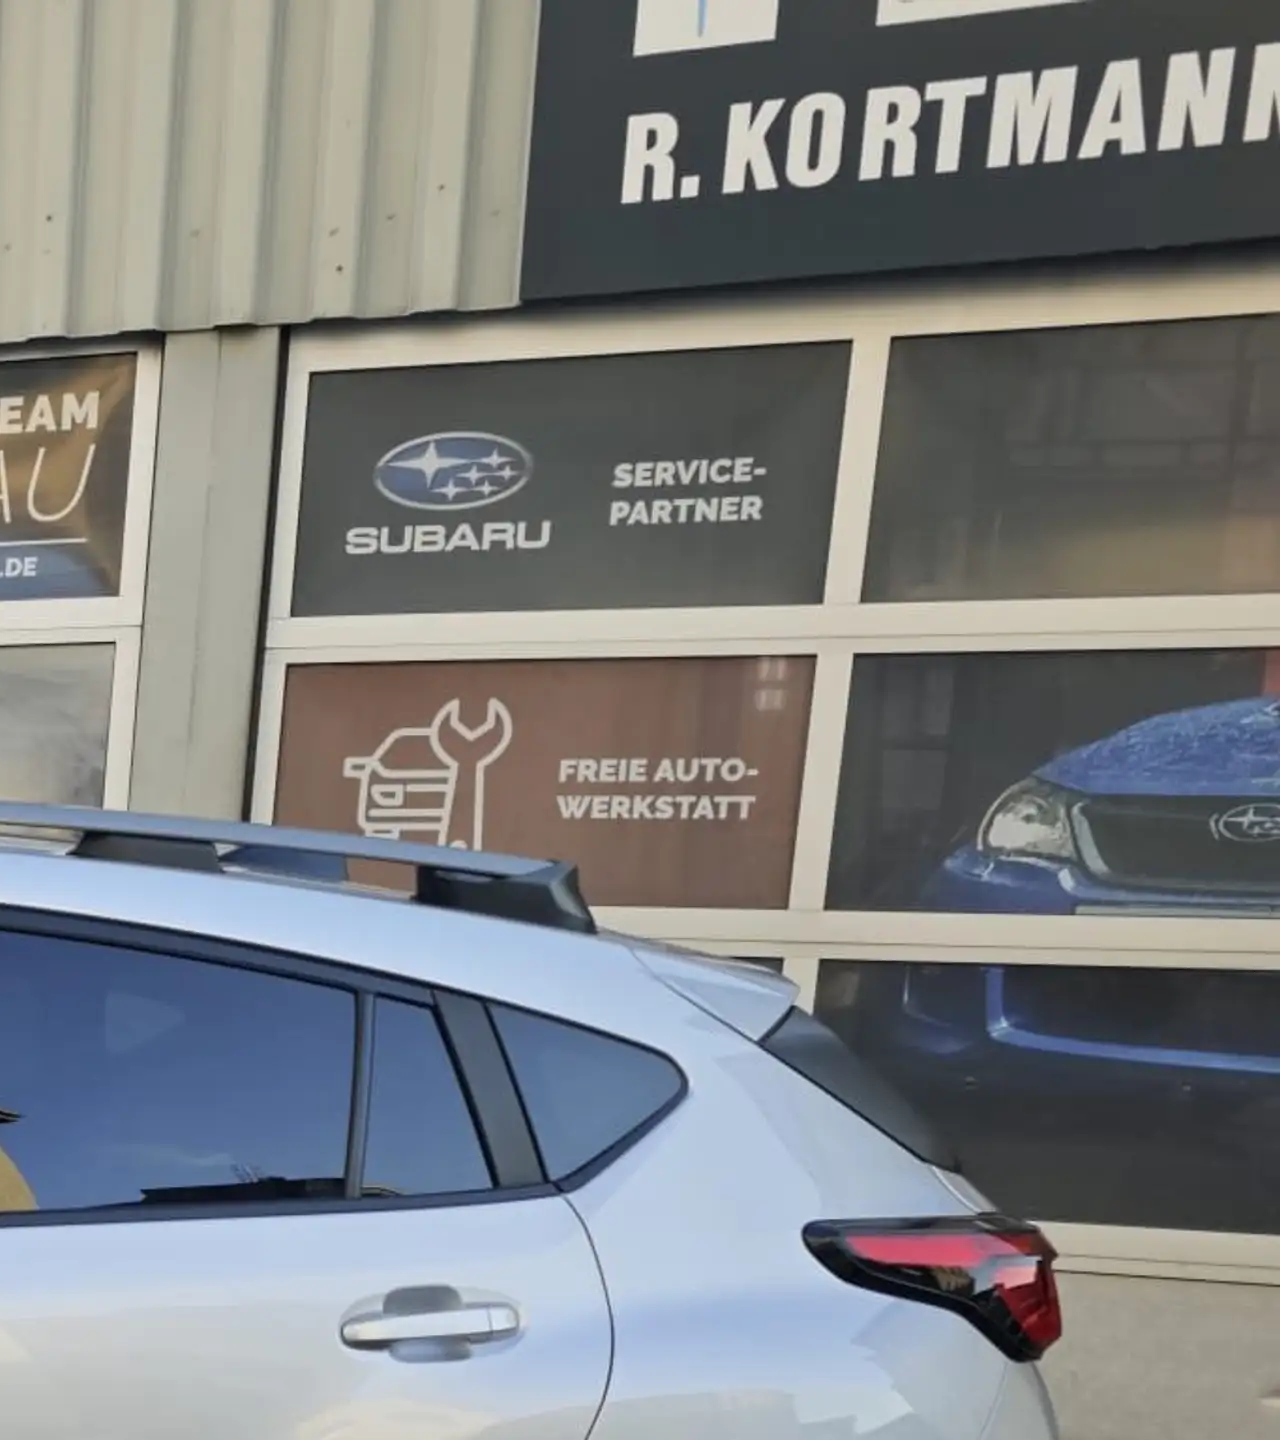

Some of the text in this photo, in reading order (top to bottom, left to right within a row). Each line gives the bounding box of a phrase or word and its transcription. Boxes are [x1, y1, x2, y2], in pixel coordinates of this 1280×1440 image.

[621, 112, 700, 204] R.
[612, 457, 767, 488] SERVICE-
[609, 495, 763, 526] PARTNER
[344, 520, 552, 555] SUBARU
[557, 756, 759, 783] FREIE AUTO-
[556, 794, 757, 820] WERKSTATT
